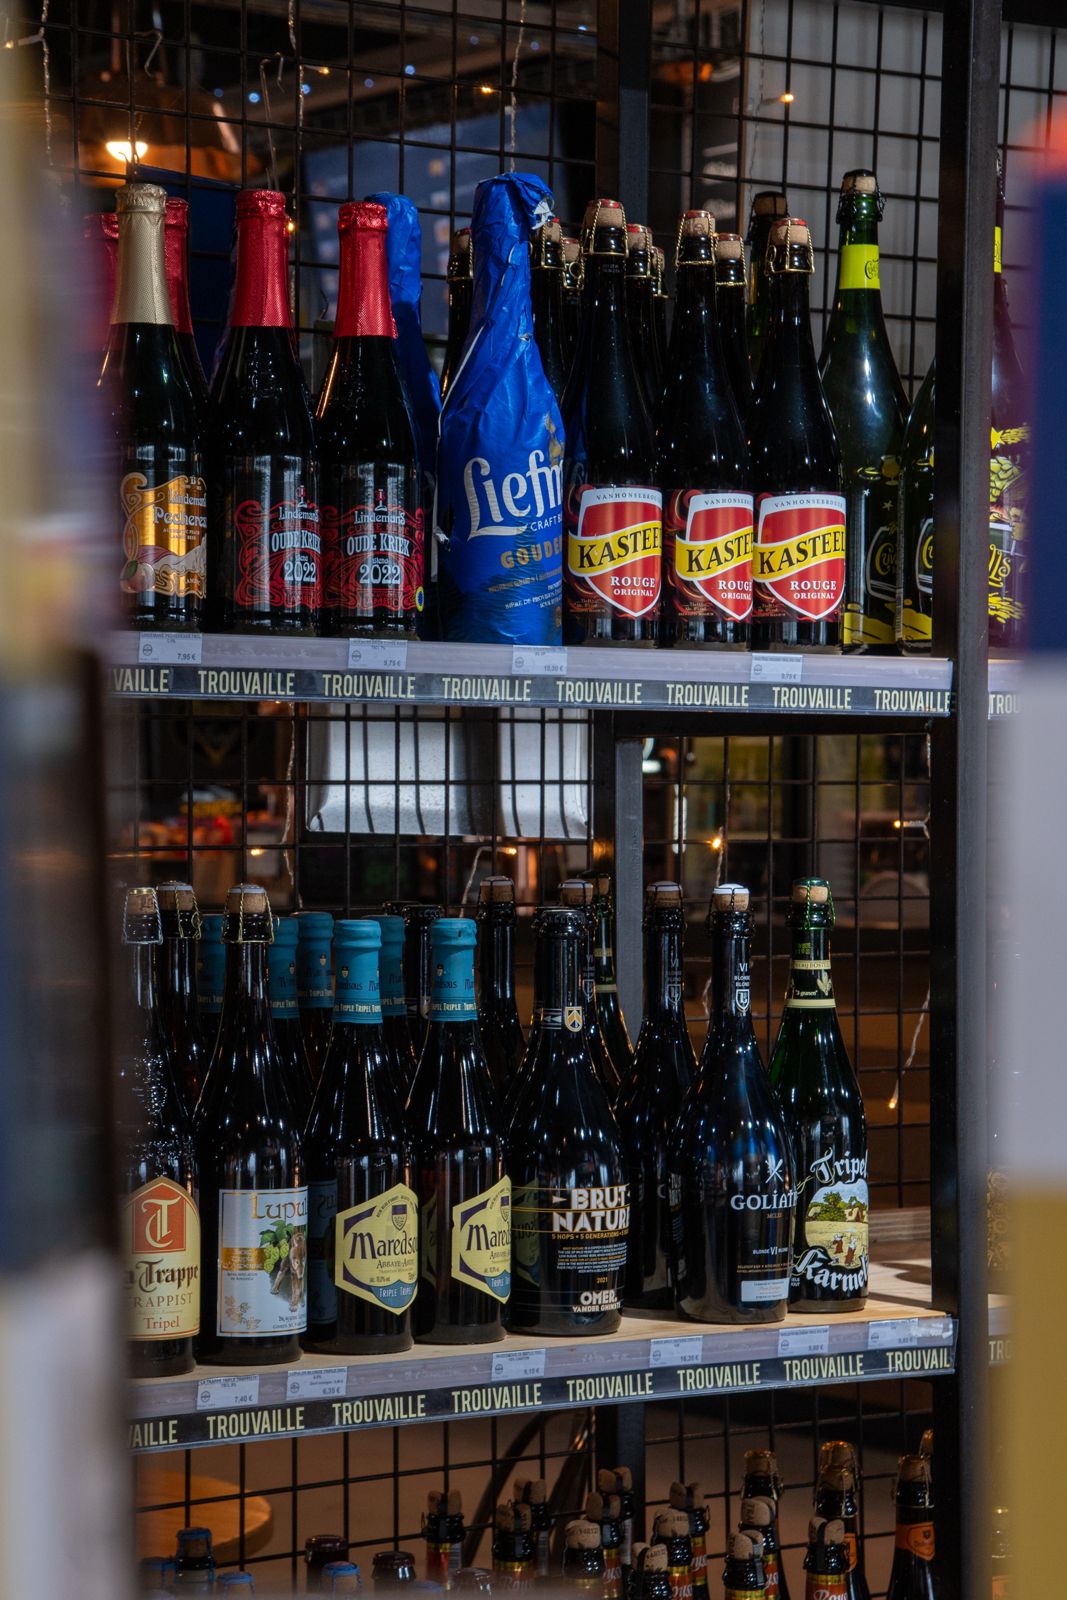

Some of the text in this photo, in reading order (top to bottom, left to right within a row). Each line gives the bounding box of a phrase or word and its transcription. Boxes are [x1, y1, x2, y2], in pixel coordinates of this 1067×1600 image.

[353, 511, 406, 525] Lindemans
[272, 530, 301, 552] OUDE
[347, 533, 410, 557] OUDE KRIEK
[578, 527, 662, 568] KASTEE
[284, 561, 317, 582] 2022
[359, 564, 402, 584] 2022
[611, 576, 656, 588] ROUGE
[790, 581, 837, 591] ROUGE
[613, 589, 653, 597] ORIGINAL
[198, 670, 295, 696] TROUVAILLE
[322, 673, 416, 699] TROUVAILLE
[442, 677, 532, 702] TROUVAILLE
[556, 680, 642, 705] TROUVAILLE
[666, 684, 749, 707] TROUVAILLE
[772, 687, 852, 710] TROUVAILLE
[874, 689, 950, 712] TROUVAILLE
[571, 1185, 629, 1210] BRUT
[557, 1232, 574, 1240] HOPS
[585, 1230, 619, 1239] GENERATIONS
[136, 1258, 199, 1293] Trappe
[572, 1305, 599, 1313] VANDER
[144, 1316, 180, 1331] Tripel
[207, 1406, 305, 1440] TROUVAILLE
[332, 1394, 426, 1426] TROUVAILLE
[452, 1382, 542, 1413] TROUVAILLE
[566, 1372, 654, 1402] TROUVAILLE
[677, 1363, 761, 1391] TROUVAILLE
[783, 1354, 864, 1381] TROUVAILLE
